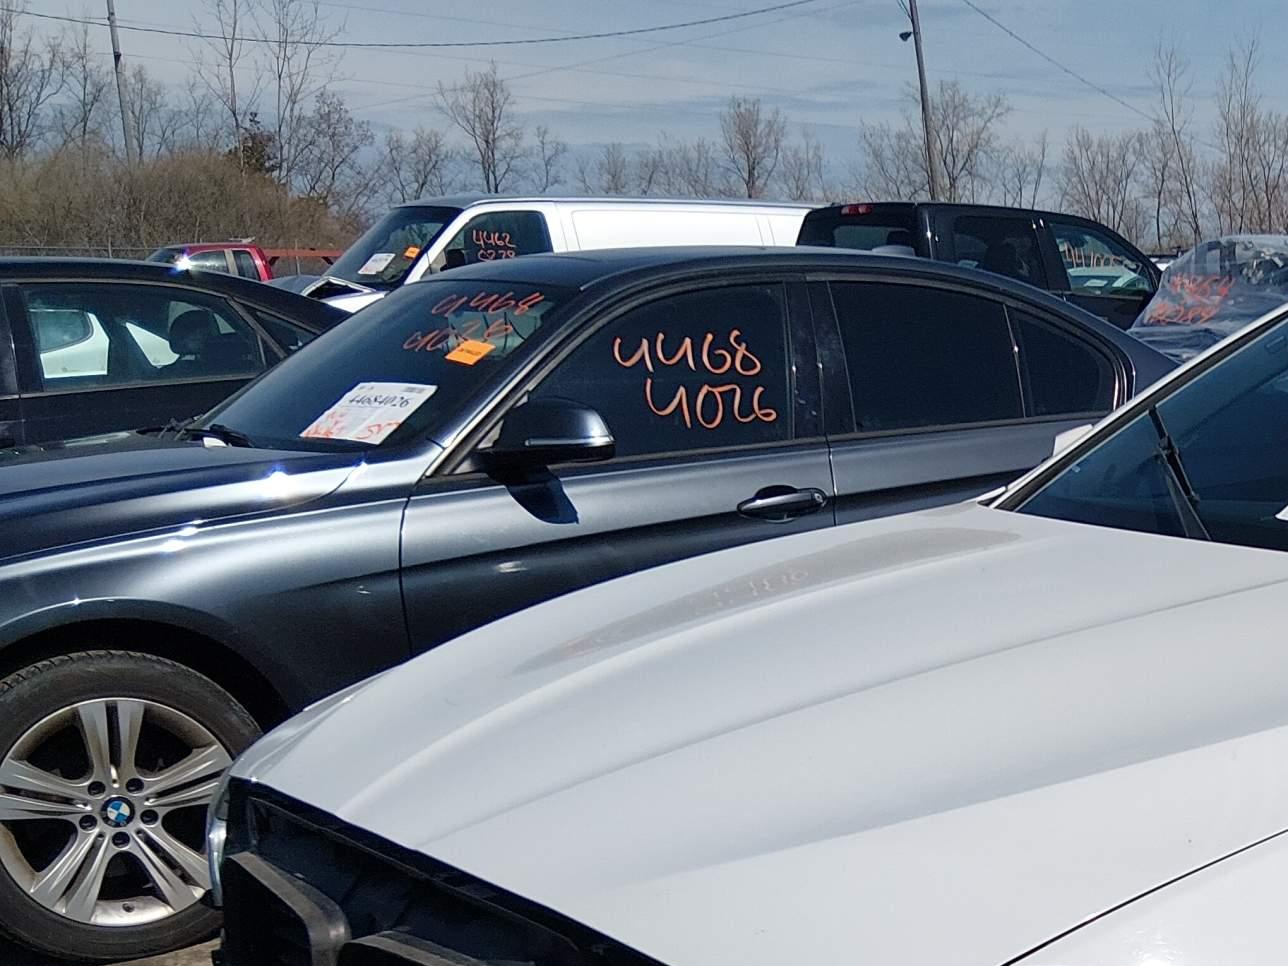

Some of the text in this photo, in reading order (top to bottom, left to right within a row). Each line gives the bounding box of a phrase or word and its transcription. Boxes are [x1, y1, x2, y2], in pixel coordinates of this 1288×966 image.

[472, 229, 517, 248] 4462
[432, 291, 545, 317] 4468
[613, 328, 762, 376] 4468
[645, 378, 778, 429] 4026
